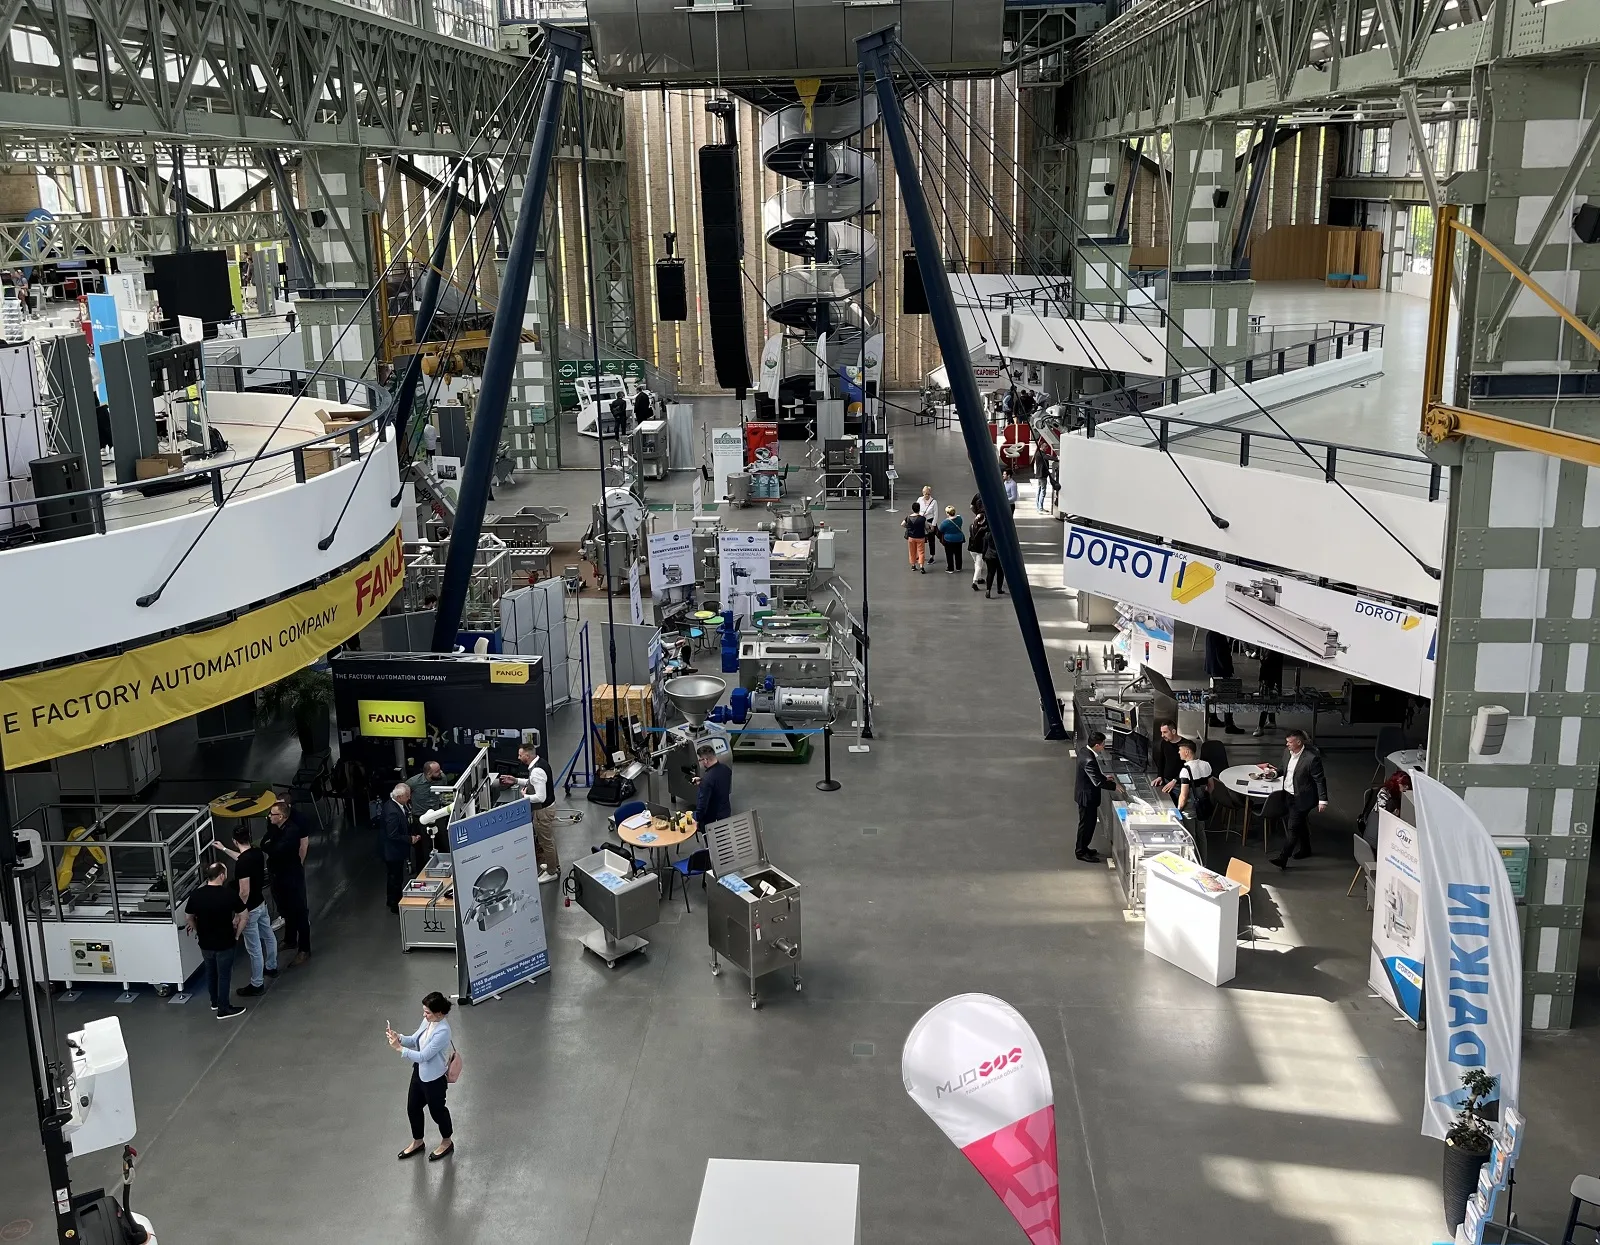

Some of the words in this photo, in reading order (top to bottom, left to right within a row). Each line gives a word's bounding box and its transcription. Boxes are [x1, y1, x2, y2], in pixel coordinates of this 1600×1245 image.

[355, 528, 403, 617] FANU
[1066, 526, 1187, 589] DOROTI
[1354, 600, 1408, 626] DOROTI
[31, 679, 142, 728] FACTORY
[150, 636, 273, 695] AUTOMATION
[279, 604, 338, 648] COMPANY
[417, 674, 447, 682] COMPANY
[368, 713, 417, 724] FANUC
